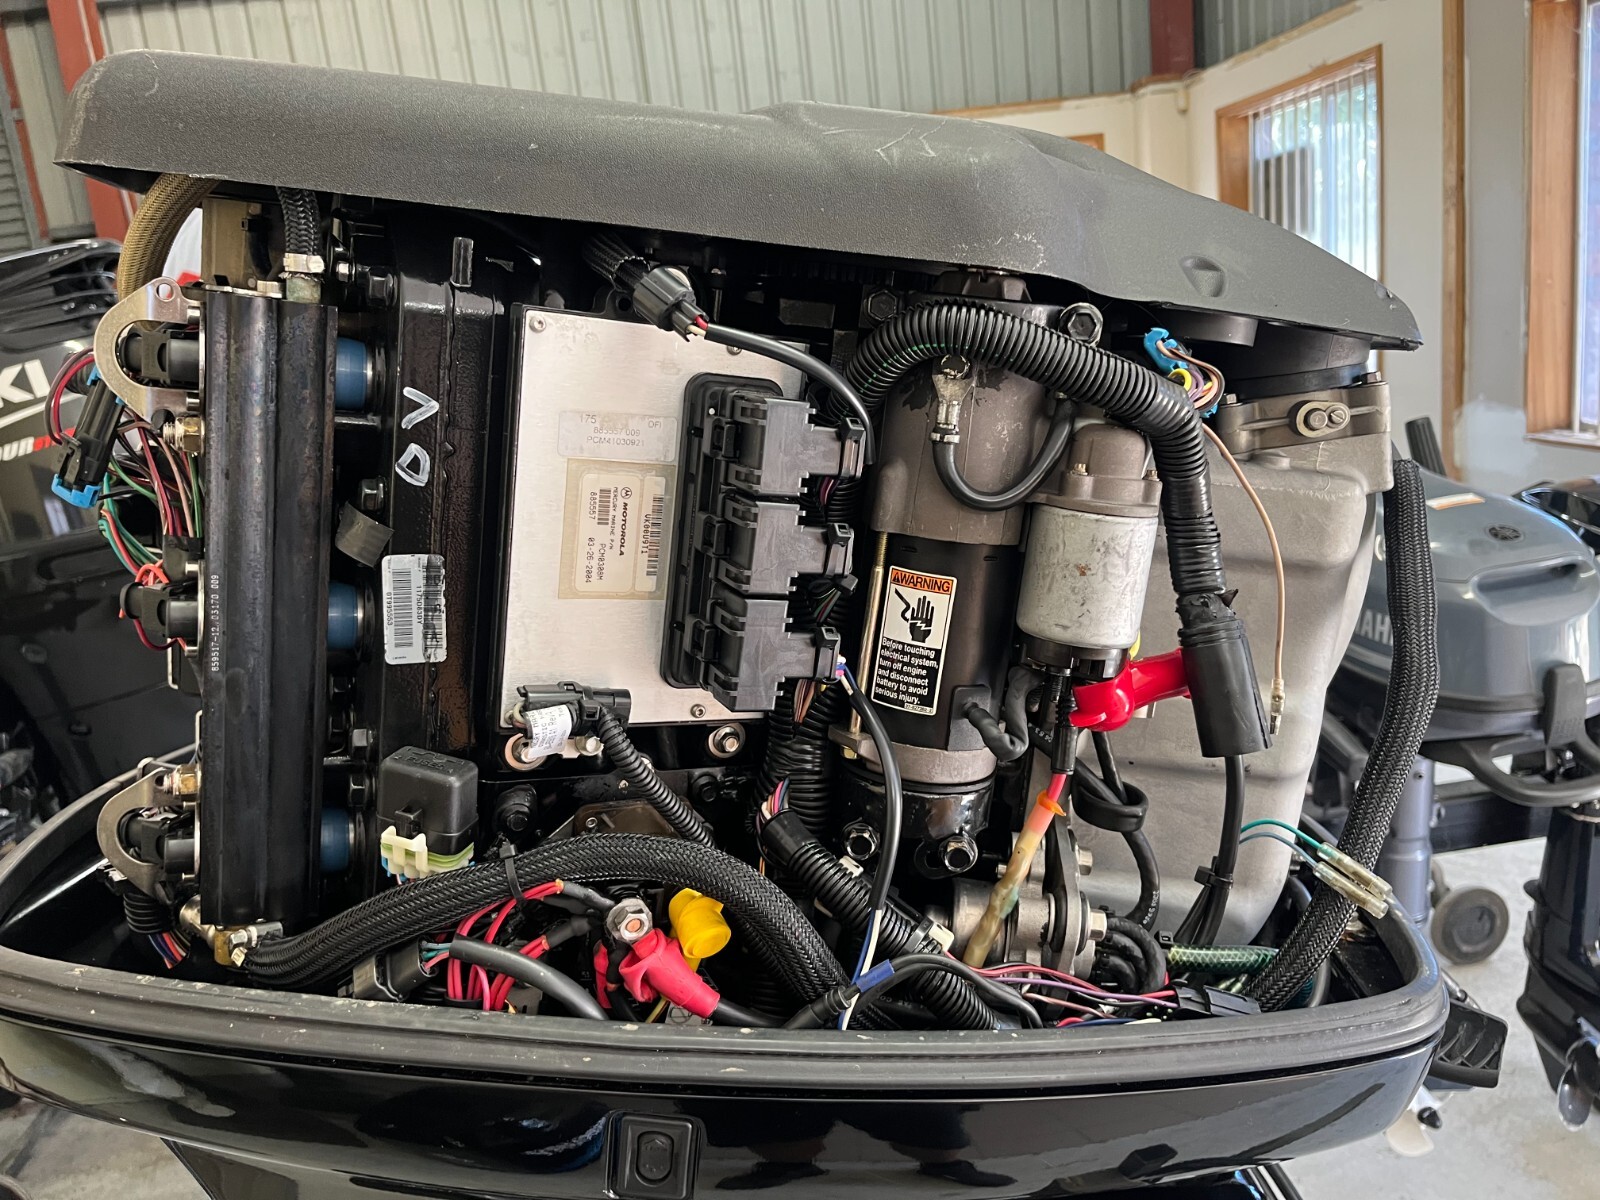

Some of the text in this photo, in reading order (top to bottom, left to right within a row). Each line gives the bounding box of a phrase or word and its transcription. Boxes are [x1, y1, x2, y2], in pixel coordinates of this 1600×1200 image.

[580, 414, 597, 424] 175
[626, 428, 641, 437] 009
[588, 491, 598, 520] 885557
[609, 514, 617, 536] MARINE
[619, 502, 629, 556] MOTOROLA
[585, 537, 596, 583] 03-26-2004
[210, 574, 219, 589] 009
[900, 572, 951, 593] WARNING
[882, 637, 935, 659] Before touching
[879, 657, 927, 676] turn off engine
[880, 649, 938, 669] electrical system,
[876, 676, 928, 696] battery to avoid
[877, 668, 929, 686] and disconnect
[875, 686, 921, 705] serious injury.
